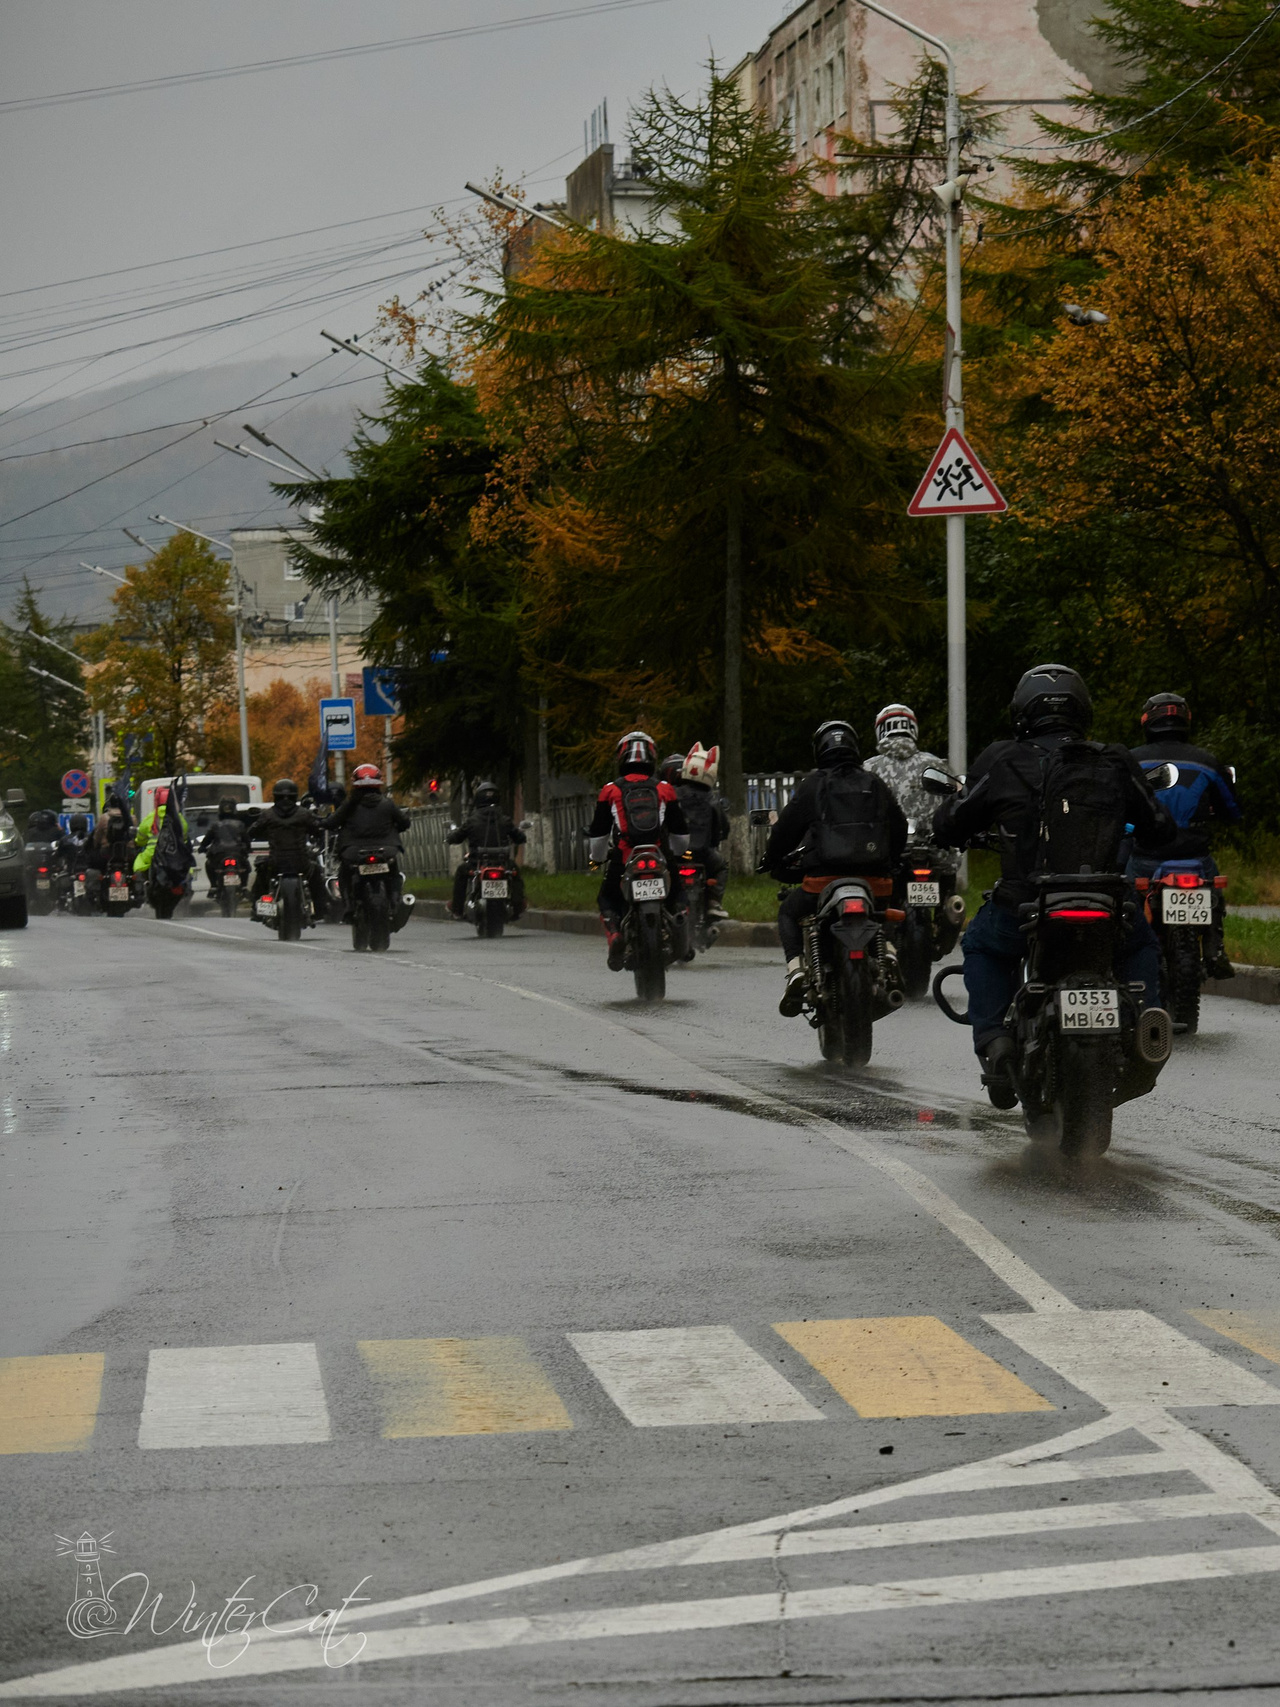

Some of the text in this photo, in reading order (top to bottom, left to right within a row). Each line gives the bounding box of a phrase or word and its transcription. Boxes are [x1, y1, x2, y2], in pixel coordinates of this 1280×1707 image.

[636, 880, 659, 888] 0470
[911, 883, 935, 892] 0366
[651, 888, 663, 896] 49
[925, 894, 938, 903] 49
[1170, 892, 1204, 905] 0269
[1191, 910, 1208, 923] 49
[1067, 991, 1110, 1005] 0353
[1095, 1012, 1115, 1027] 49
